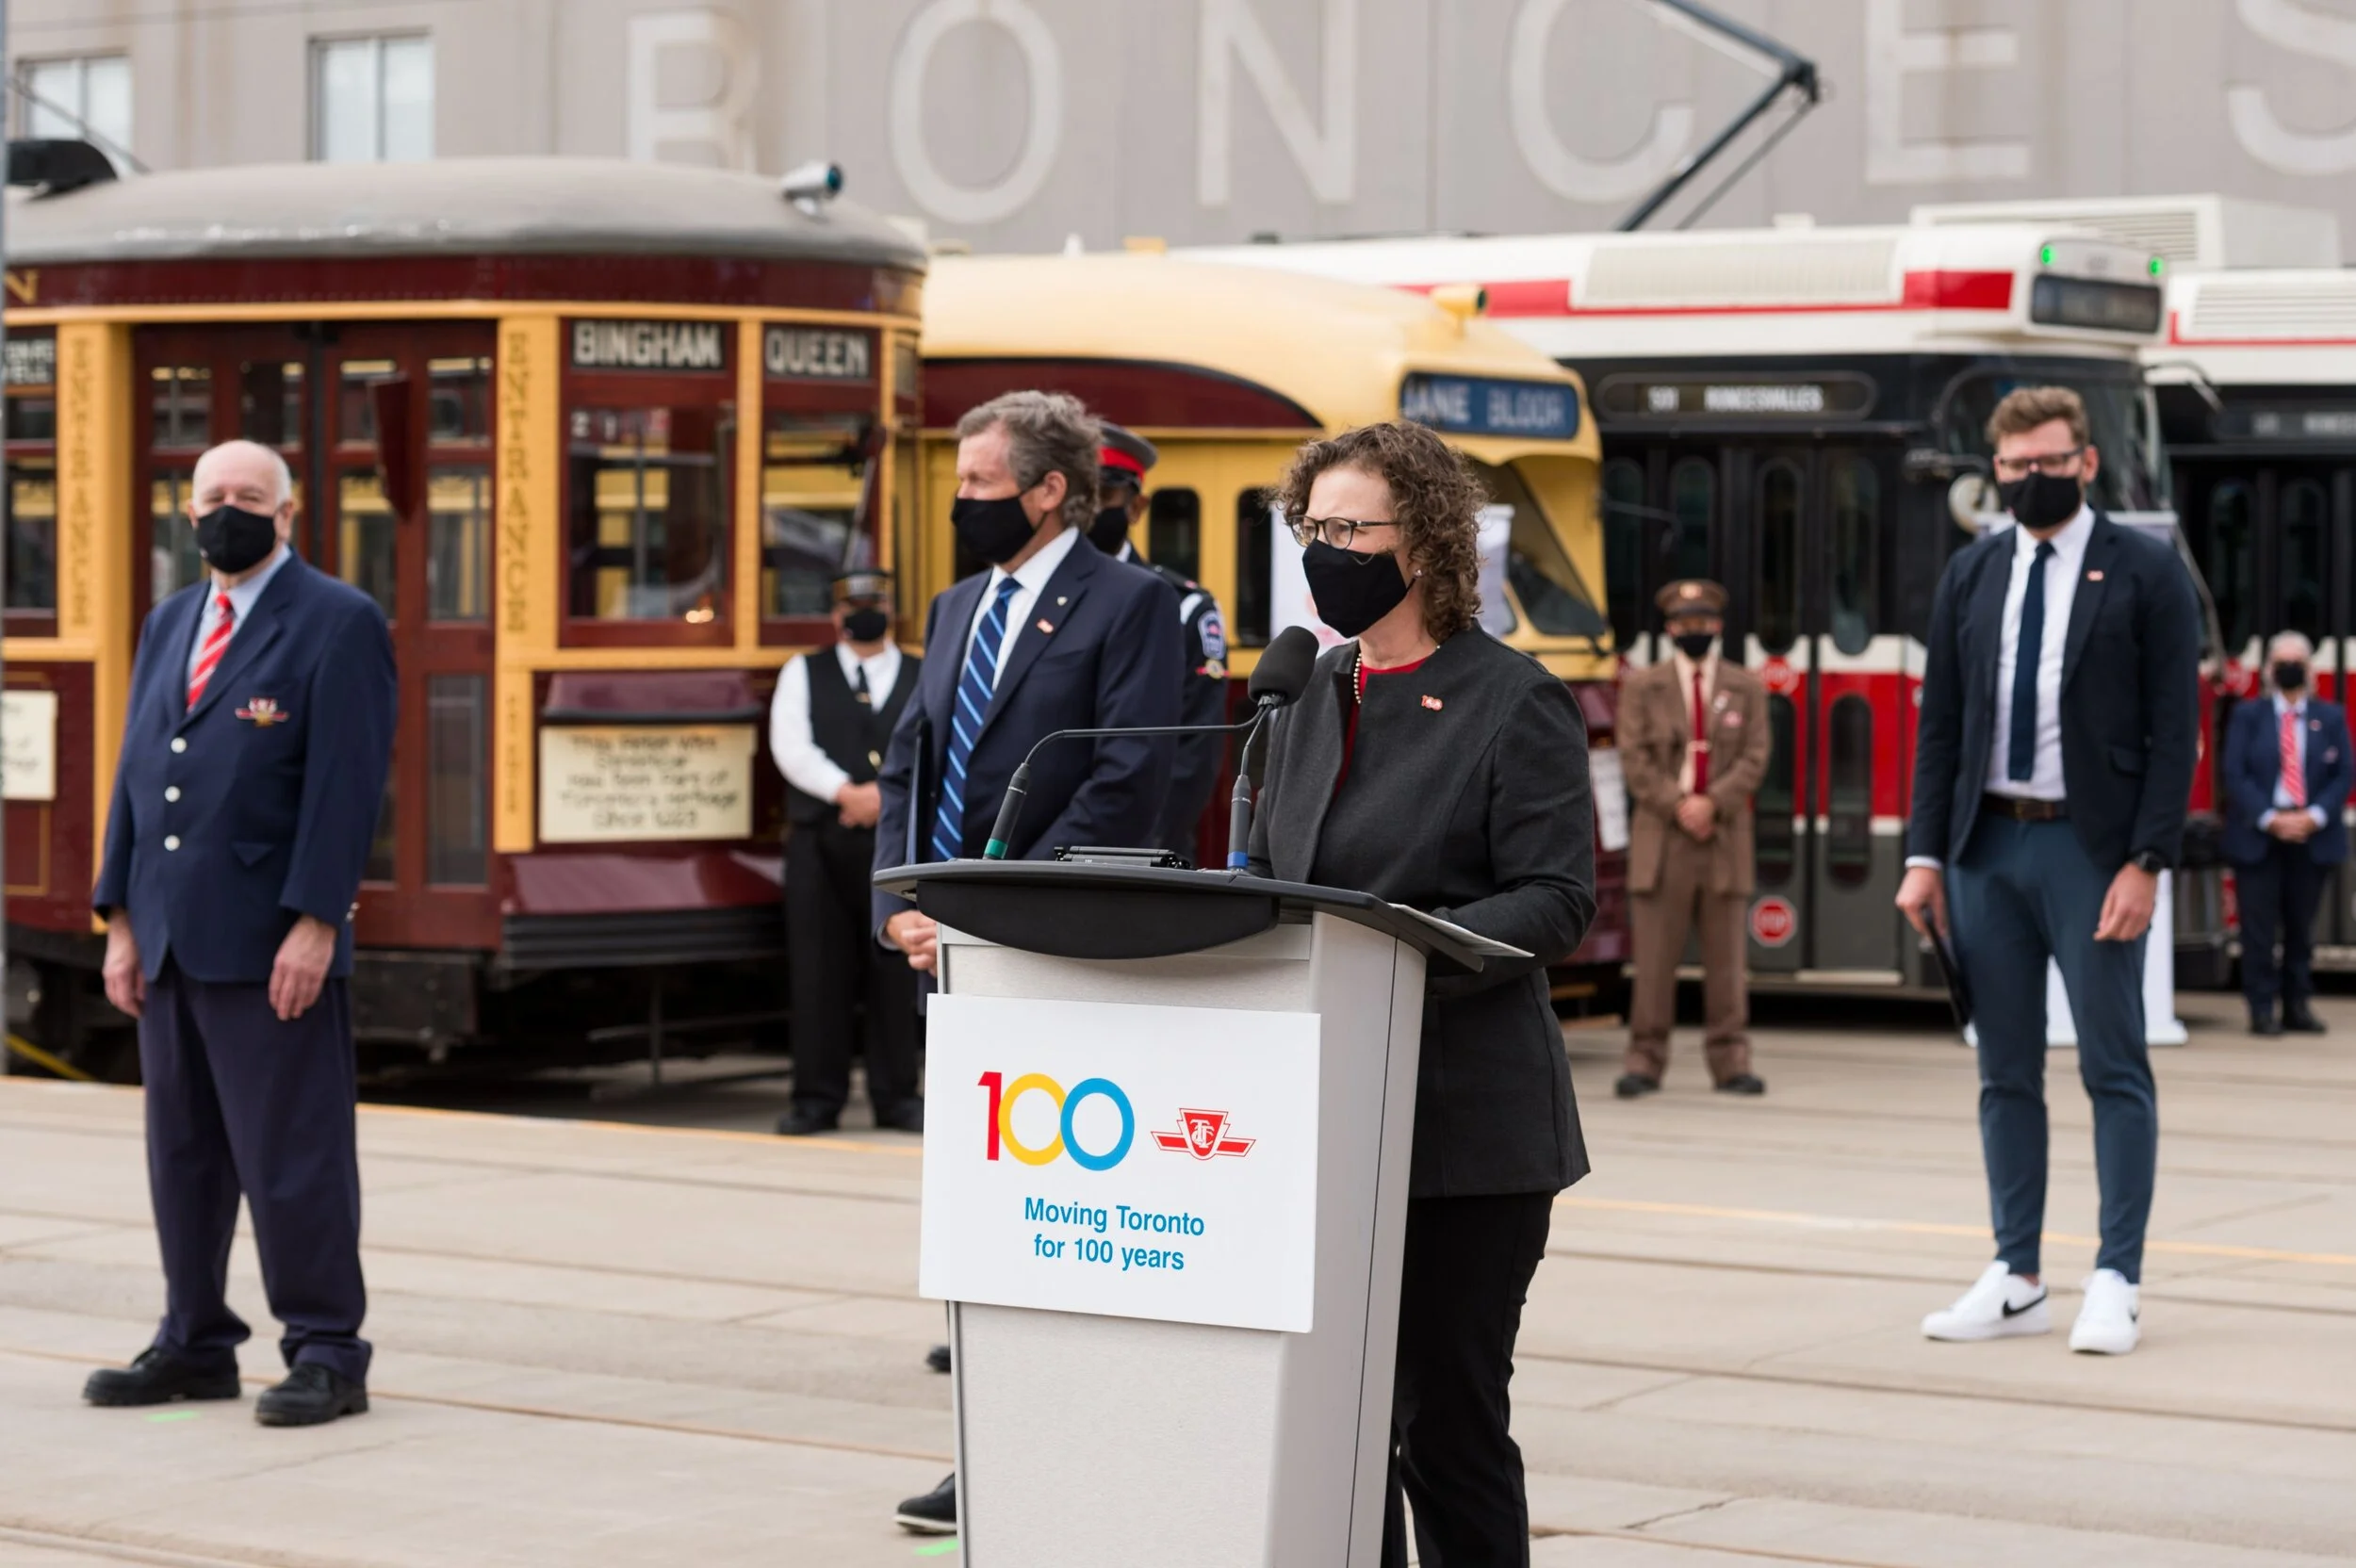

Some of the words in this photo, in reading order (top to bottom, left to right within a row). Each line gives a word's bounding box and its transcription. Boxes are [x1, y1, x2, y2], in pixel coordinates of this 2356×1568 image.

[573, 320, 722, 367] BINGHAM
[765, 329, 869, 376] QUEEN
[1402, 377, 1470, 424] JANE
[1486, 386, 1565, 429] BLOOR
[505, 332, 531, 633] ENTRANCE
[977, 1070, 1136, 1171] 100
[1024, 1196, 1107, 1233] Moving
[1116, 1204, 1205, 1236] Toronto
[1034, 1233, 1066, 1259] for
[1074, 1237, 1114, 1264] 100
[1121, 1246, 1186, 1272] years
